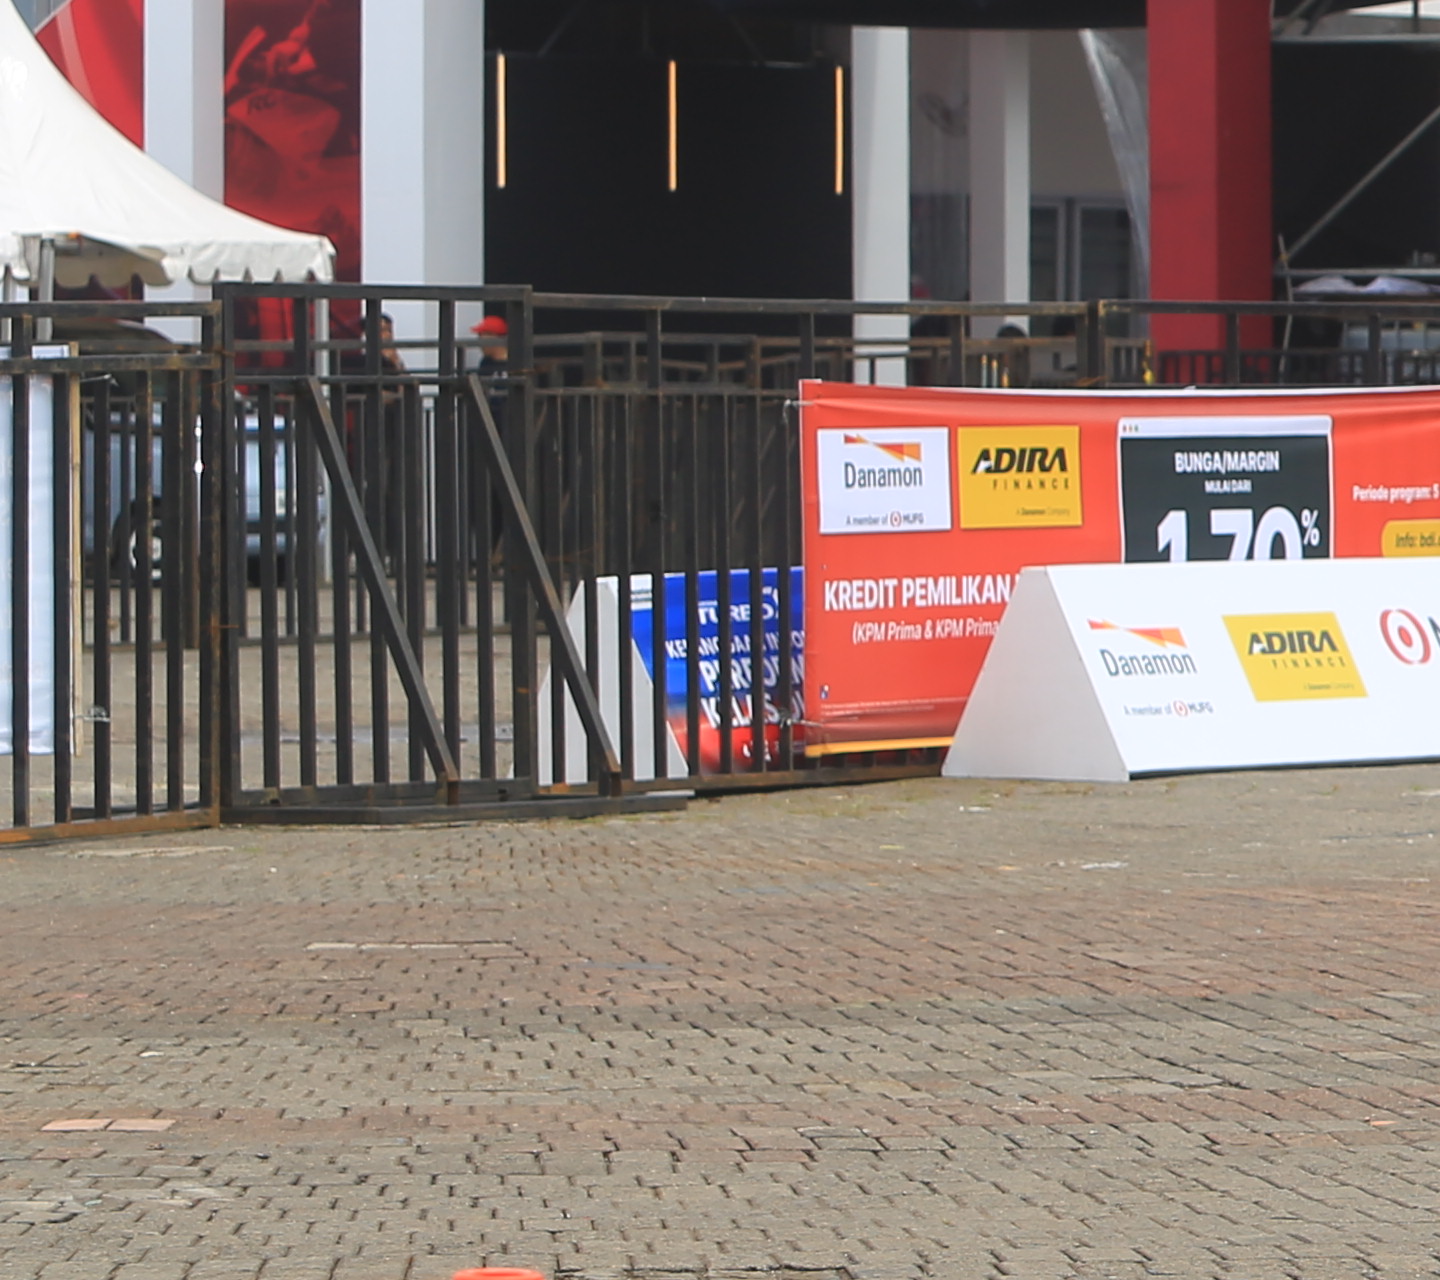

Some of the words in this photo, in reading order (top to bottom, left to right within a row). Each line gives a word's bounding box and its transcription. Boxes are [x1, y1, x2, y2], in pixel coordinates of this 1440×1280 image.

[844, 461, 923, 489] Danamon
[970, 448, 1068, 475] ADIRA
[1174, 451, 1280, 474] BUNGA/MARGIN
[993, 477, 1069, 491] FINANCE
[1352, 484, 1388, 501] Periode
[1432, 483, 1440, 499] 5
[824, 578, 898, 612] KREDIT
[902, 573, 1012, 608] PEMILIKAN
[852, 620, 887, 645] (KPM
[888, 620, 922, 642] Prima
[924, 620, 932, 639] &
[935, 618, 964, 639] KPM
[966, 617, 1000, 638] Prima
[1247, 629, 1339, 656] ADIRA
[1099, 648, 1197, 677] Danamon
[1271, 656, 1346, 670] FINANCE
